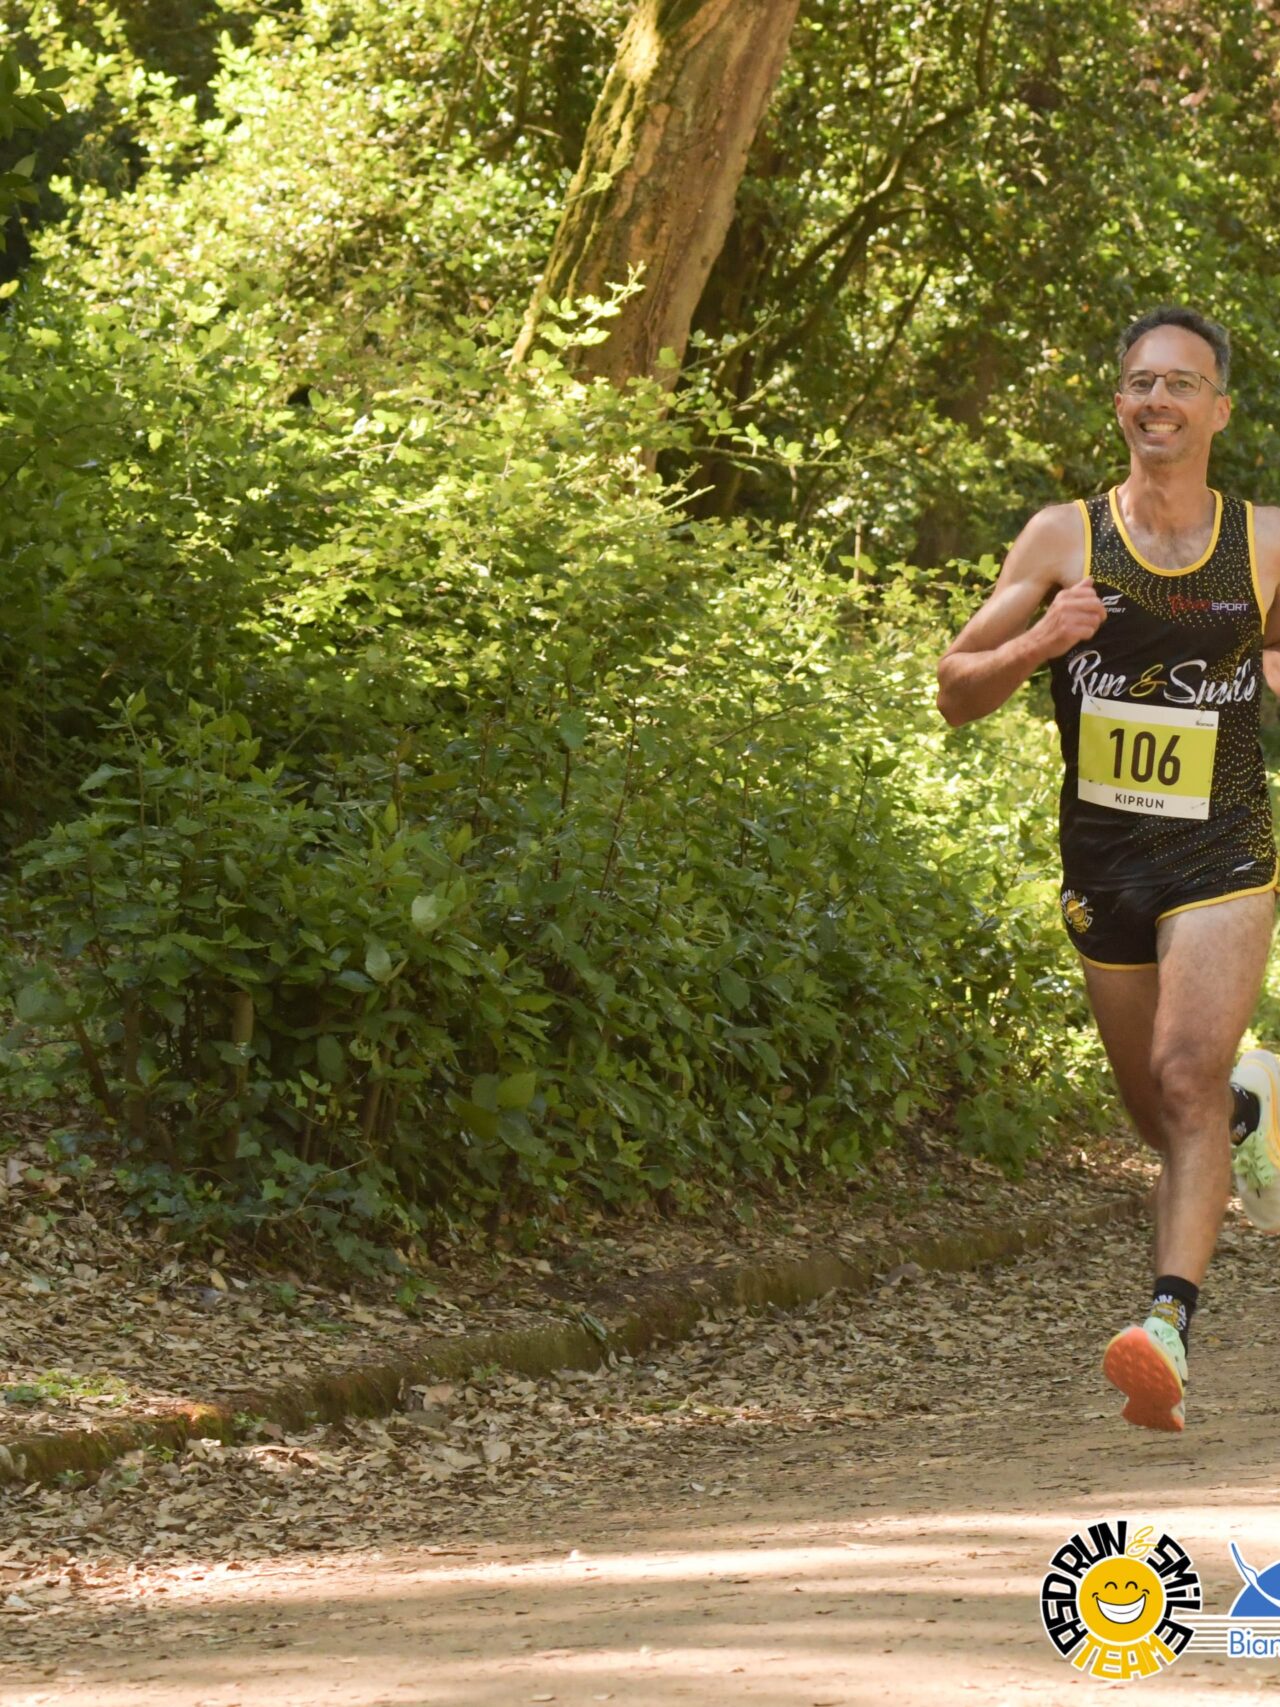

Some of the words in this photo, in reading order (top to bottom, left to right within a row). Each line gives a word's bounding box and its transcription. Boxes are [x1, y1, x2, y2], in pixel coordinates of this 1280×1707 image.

[1211, 602, 1249, 612] SPORT
[1068, 650, 1127, 698] Run
[1129, 664, 1168, 697] &
[1109, 727, 1182, 786] 106
[1114, 792, 1165, 810] KIPRUN
